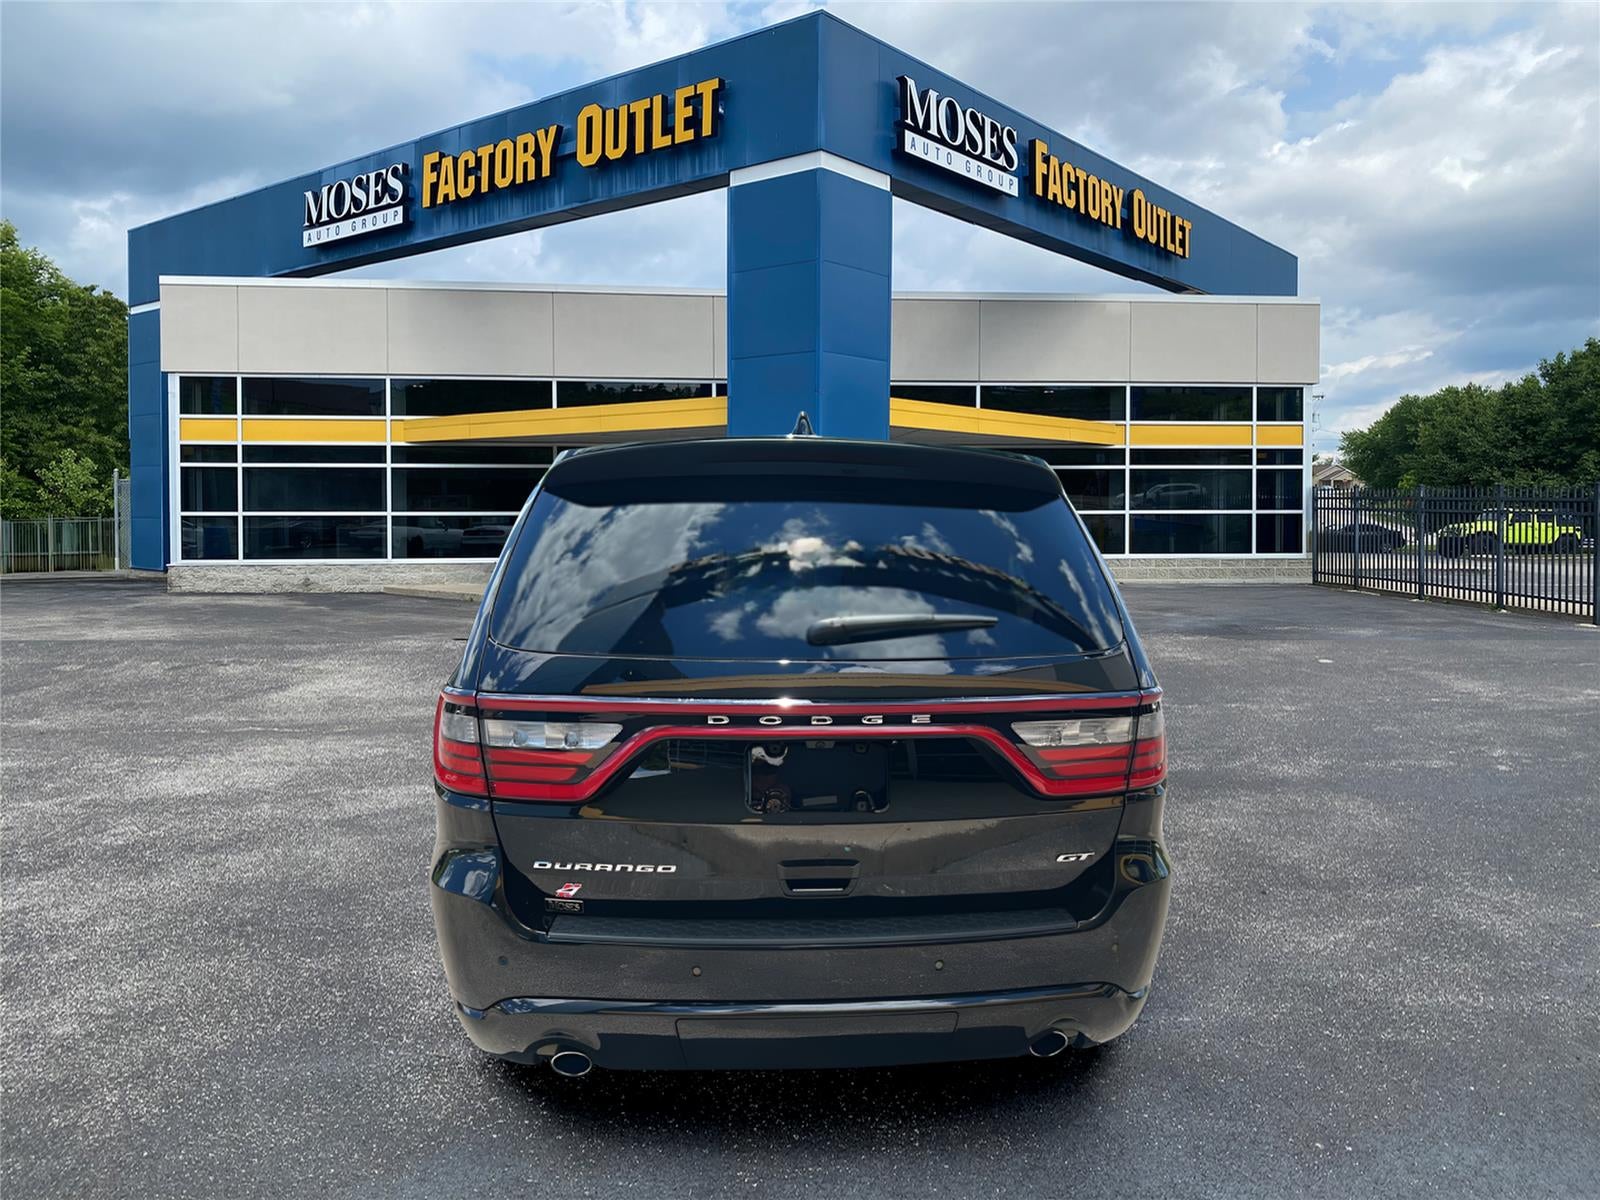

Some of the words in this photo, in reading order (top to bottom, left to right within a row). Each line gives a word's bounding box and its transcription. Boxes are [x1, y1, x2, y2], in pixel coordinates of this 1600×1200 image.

[904, 75, 1018, 171] MOSES
[910, 137, 952, 165] AUTO
[965, 159, 1015, 191] GROUP
[303, 163, 404, 226] MOSES
[306, 225, 341, 244] AUTO
[351, 210, 401, 231] GROUP
[707, 714, 932, 725] DODGE
[533, 861, 677, 873] DURANGO
[1056, 852, 1095, 863] GT
